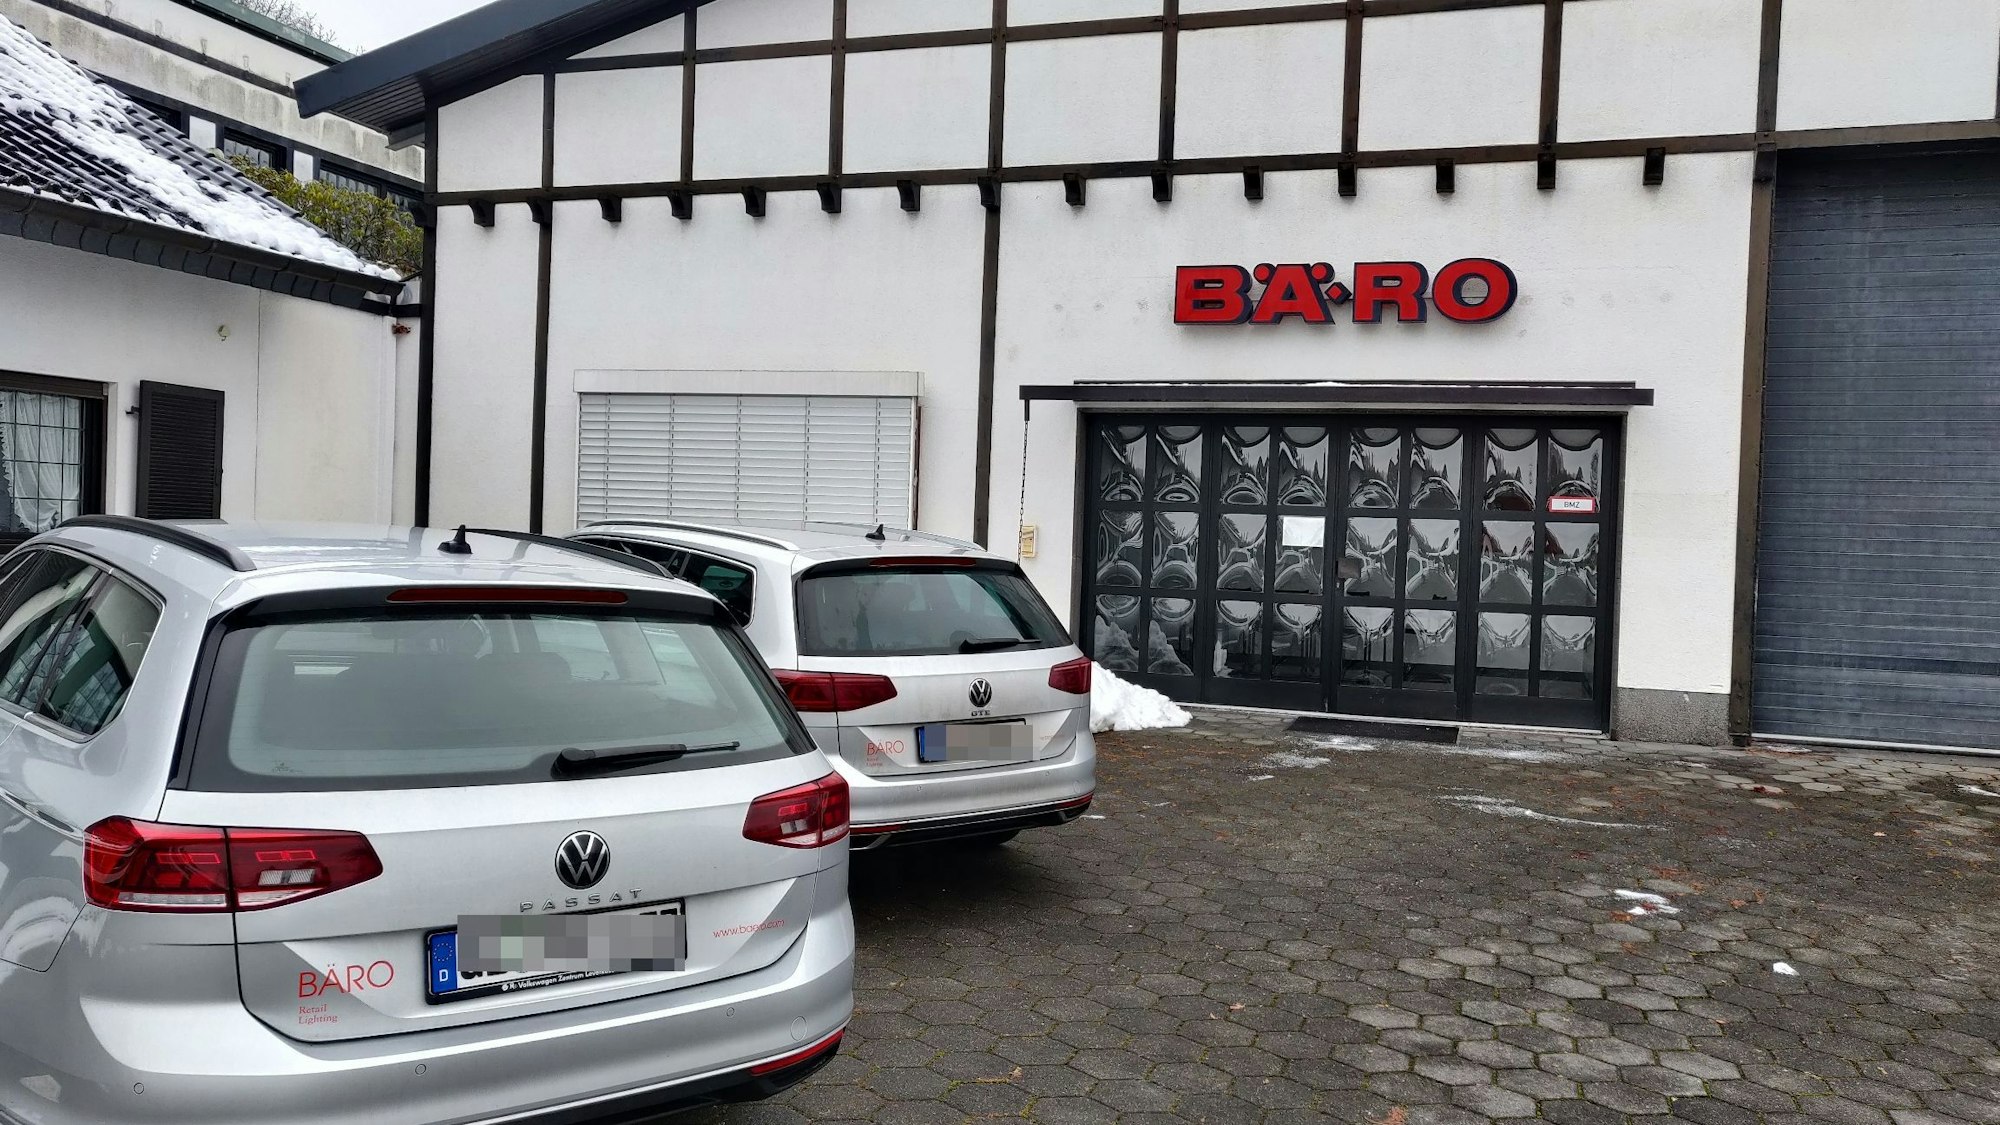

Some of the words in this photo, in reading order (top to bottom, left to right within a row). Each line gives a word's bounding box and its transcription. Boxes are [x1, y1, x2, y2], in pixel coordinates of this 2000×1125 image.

[1563, 501, 1580, 509] BMZ
[520, 888, 642, 913] PASSAT
[298, 960, 394, 998] BÄRO
[439, 969, 449, 982] D
[518, 977, 557, 989] Volkswagen
[558, 973, 584, 982] Zentrum
[299, 1004, 328, 1015] Retail
[298, 1015, 338, 1025] Lighting
